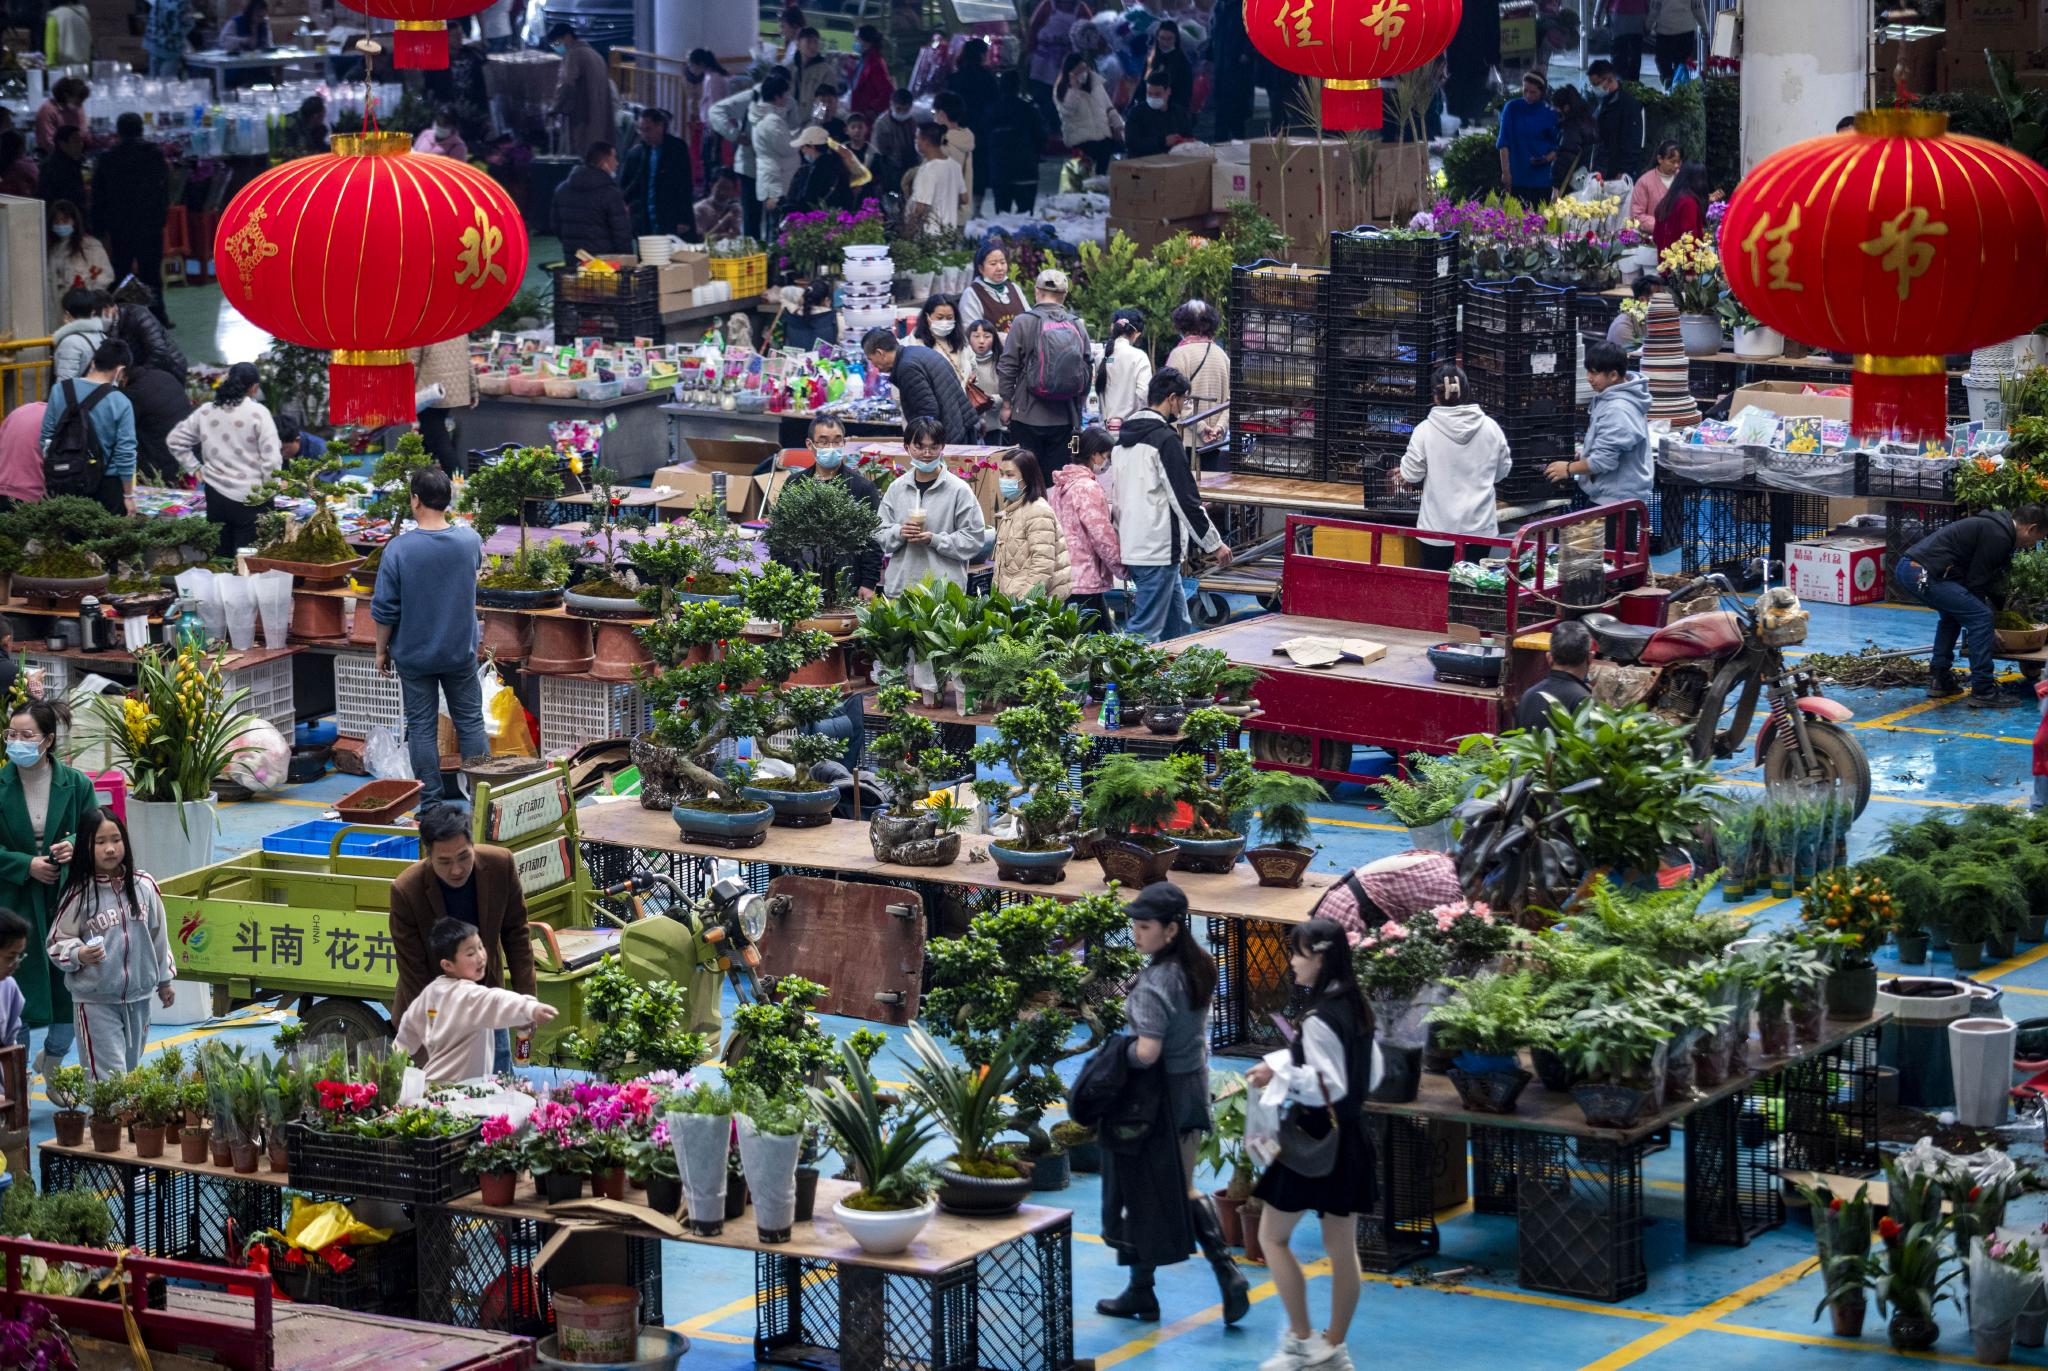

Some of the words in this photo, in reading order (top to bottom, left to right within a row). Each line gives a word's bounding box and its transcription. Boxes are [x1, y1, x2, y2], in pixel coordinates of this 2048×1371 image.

[1741, 201, 1949, 301] 佳节
[232, 920, 305, 966] 斗南
[312, 914, 321, 945] CHINA
[325, 927, 397, 974] 花卉
